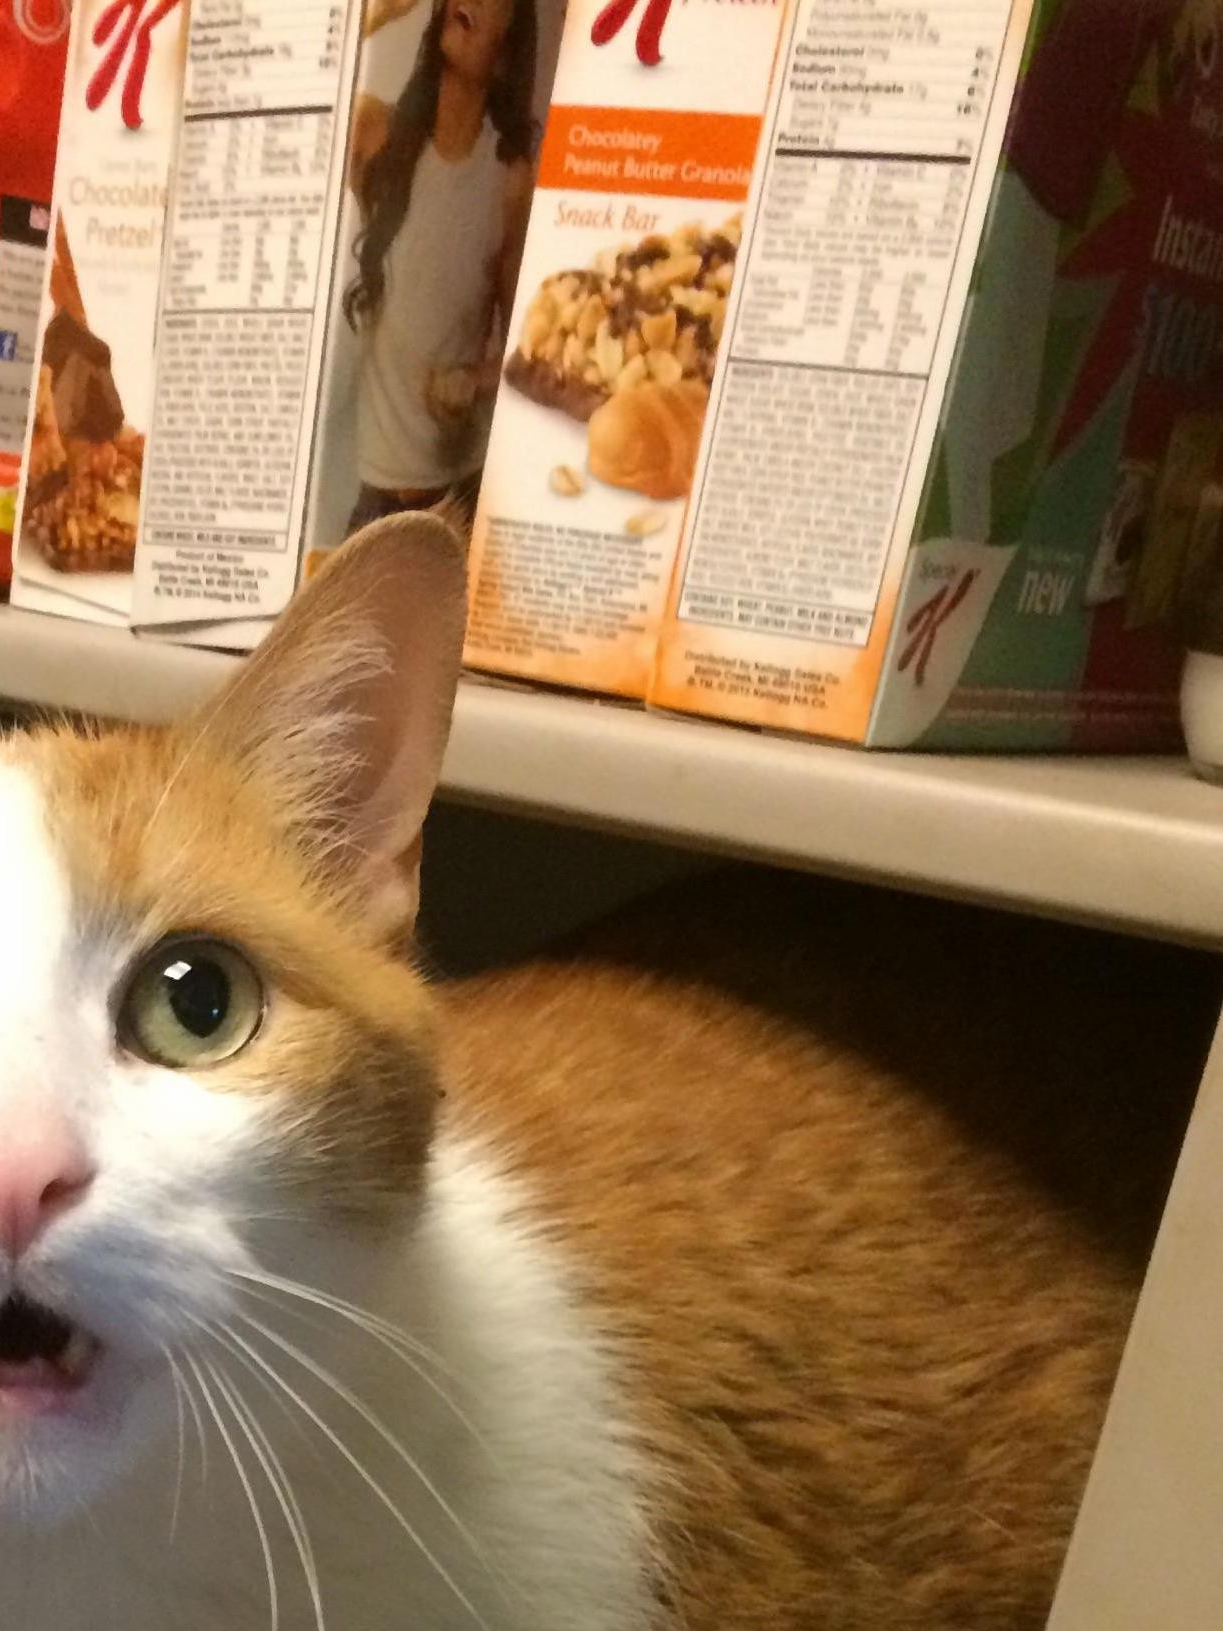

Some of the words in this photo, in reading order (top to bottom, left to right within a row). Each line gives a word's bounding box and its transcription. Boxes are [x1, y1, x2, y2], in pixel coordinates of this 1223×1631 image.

[623, 155, 676, 180] Butter
[554, 201, 614, 229] Snack
[622, 205, 661, 231] Bar
[1015, 570, 1075, 617] new
